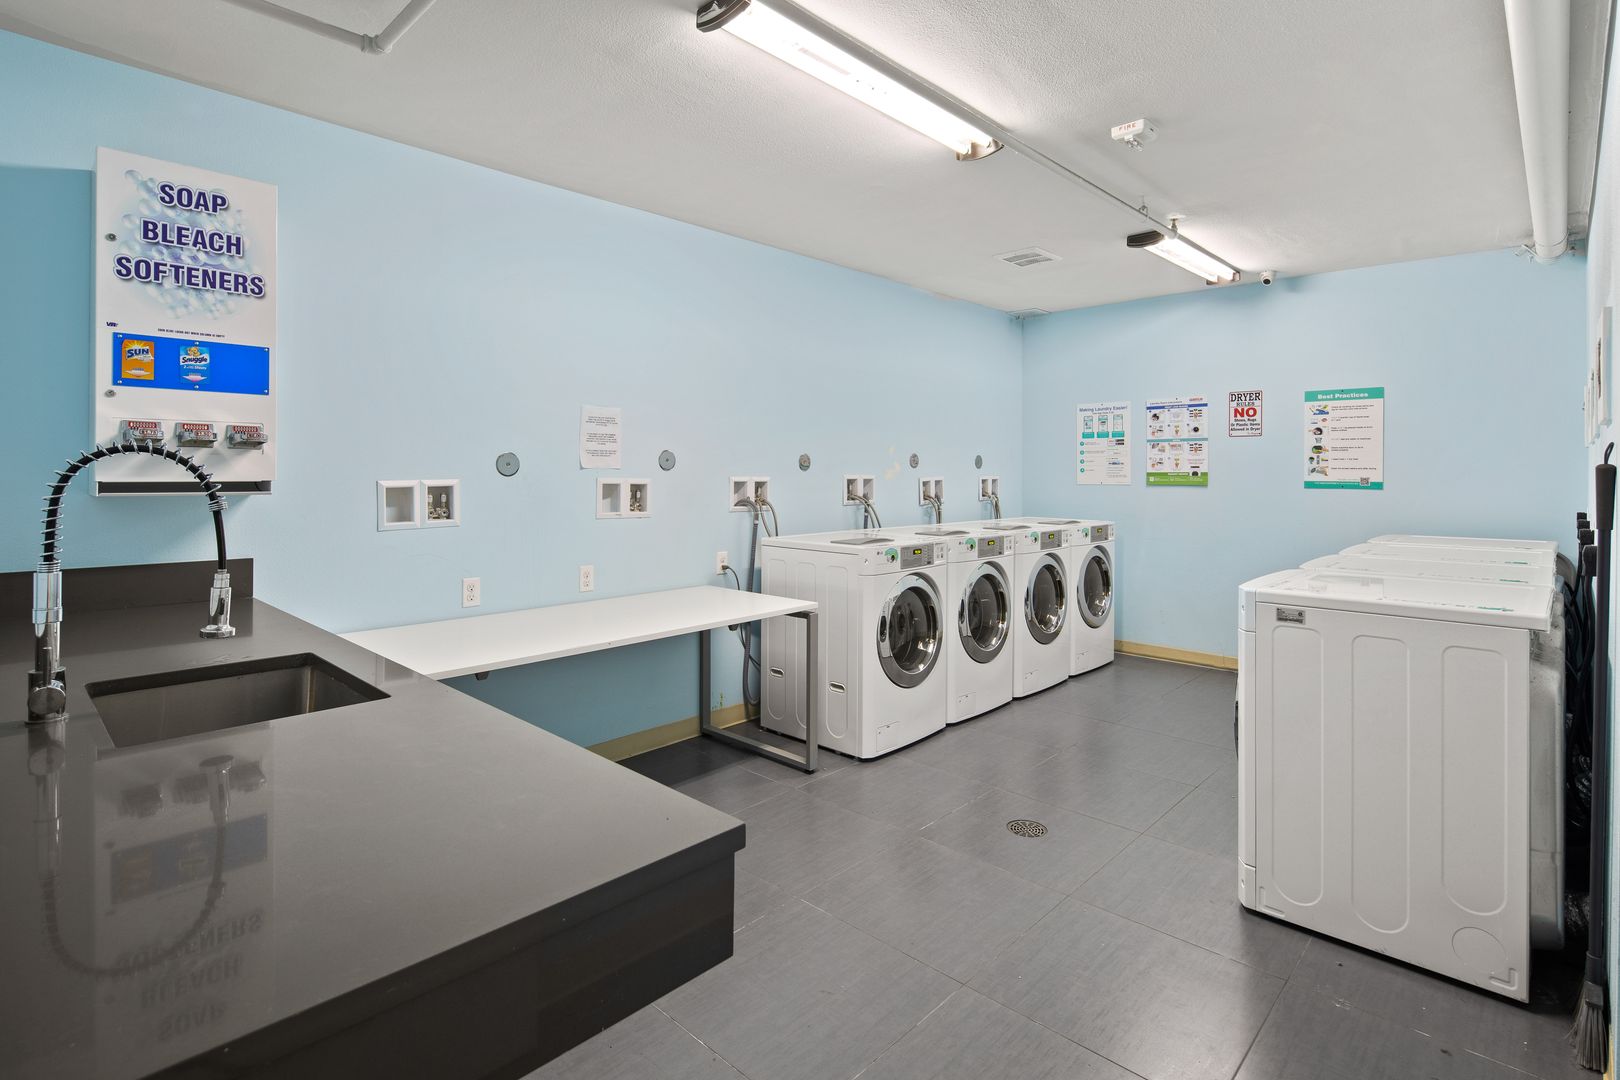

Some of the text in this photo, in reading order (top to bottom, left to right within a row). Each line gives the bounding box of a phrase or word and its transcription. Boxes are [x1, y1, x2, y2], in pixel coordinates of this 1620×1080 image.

[1119, 122, 1137, 131] FIRE
[158, 182, 228, 214] SOAP
[141, 218, 242, 256] BLEACH
[114, 255, 264, 296] SOFTENERS
[126, 348, 150, 359] SUN
[181, 355, 208, 363] Snuggle
[1230, 392, 1261, 402] DRYER
[1233, 407, 1258, 418] NO
